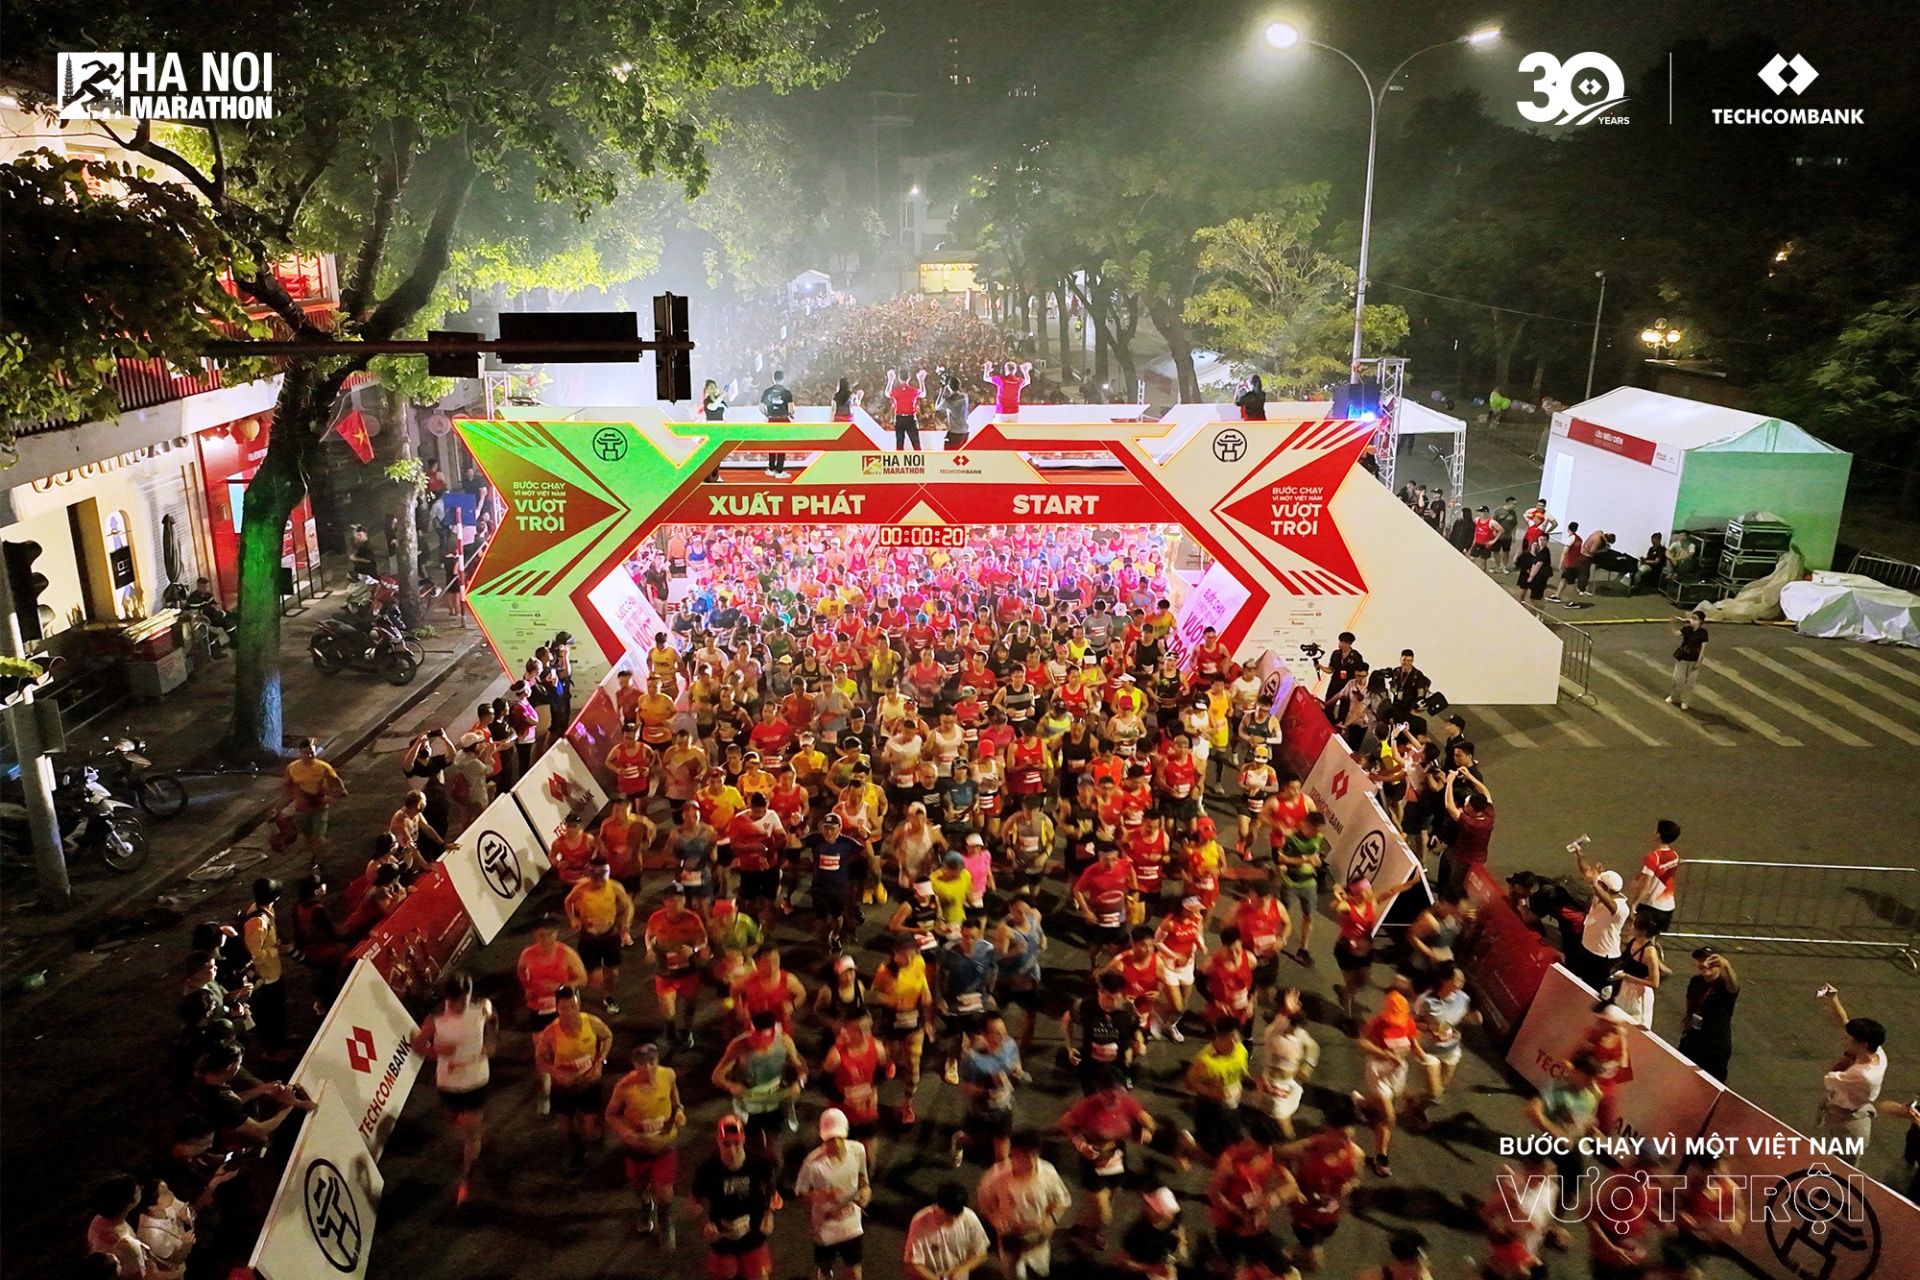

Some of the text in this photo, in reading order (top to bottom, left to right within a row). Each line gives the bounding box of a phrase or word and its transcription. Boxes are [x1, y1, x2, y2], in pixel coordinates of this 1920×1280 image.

[882, 455, 925, 467] HA NOI
[882, 467, 925, 475] MARATHON
[708, 489, 866, 516] XUẤT PHÁT
[1012, 494, 1100, 515] START
[880, 527, 964, 546] 00:00:20
[358, 1034, 412, 1140] TECHCOMBANK
